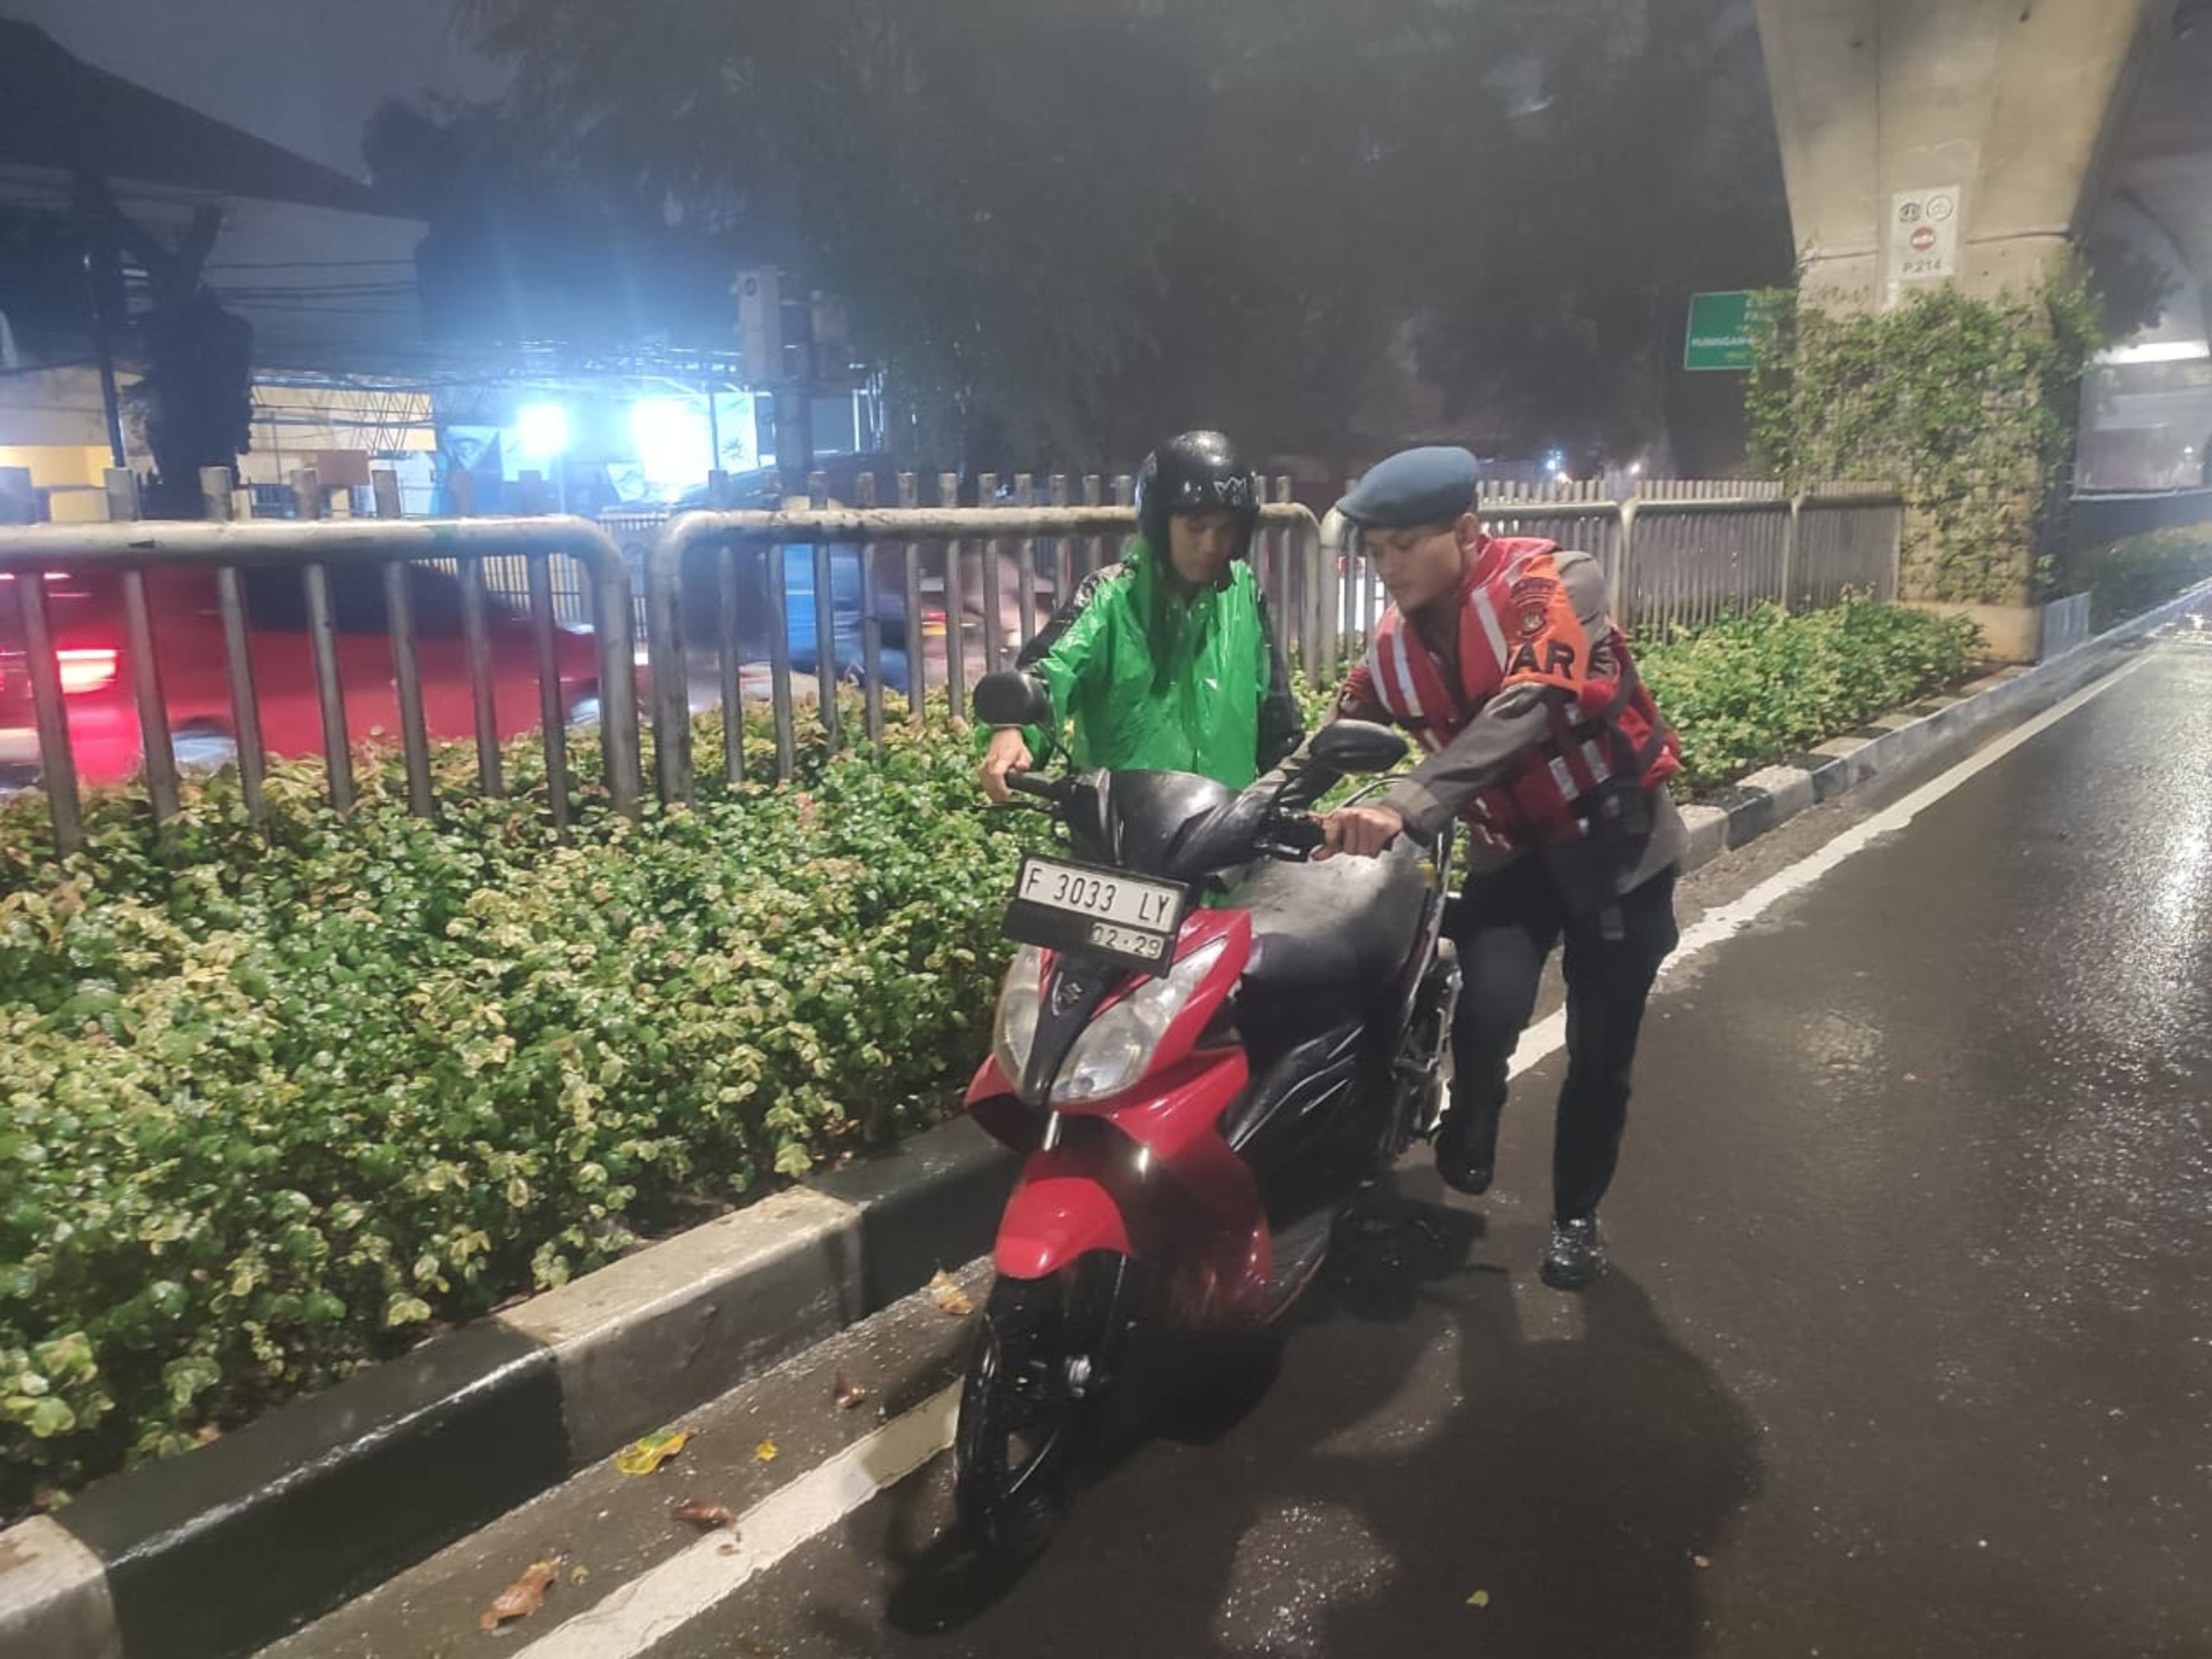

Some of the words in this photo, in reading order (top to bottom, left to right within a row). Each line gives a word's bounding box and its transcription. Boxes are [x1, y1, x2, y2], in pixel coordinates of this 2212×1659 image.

[1026, 868, 1042, 895] F
[1053, 874, 1116, 912] 3033
[1138, 892, 1170, 924] LY
